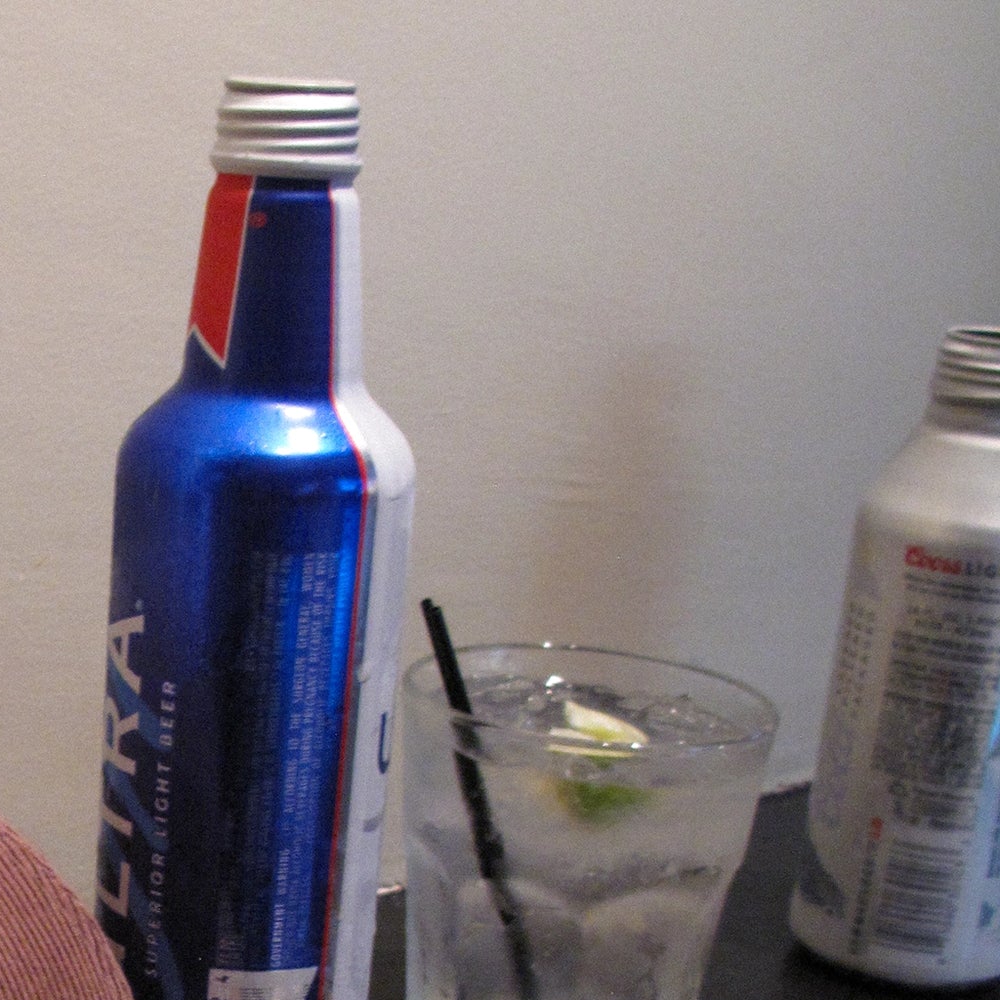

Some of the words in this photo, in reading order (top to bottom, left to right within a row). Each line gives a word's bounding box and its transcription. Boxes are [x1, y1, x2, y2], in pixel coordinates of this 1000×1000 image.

[160, 680, 176, 746] BEER
[154, 761, 171, 838] LIGHT
[144, 852, 166, 978] SUPERIOR
